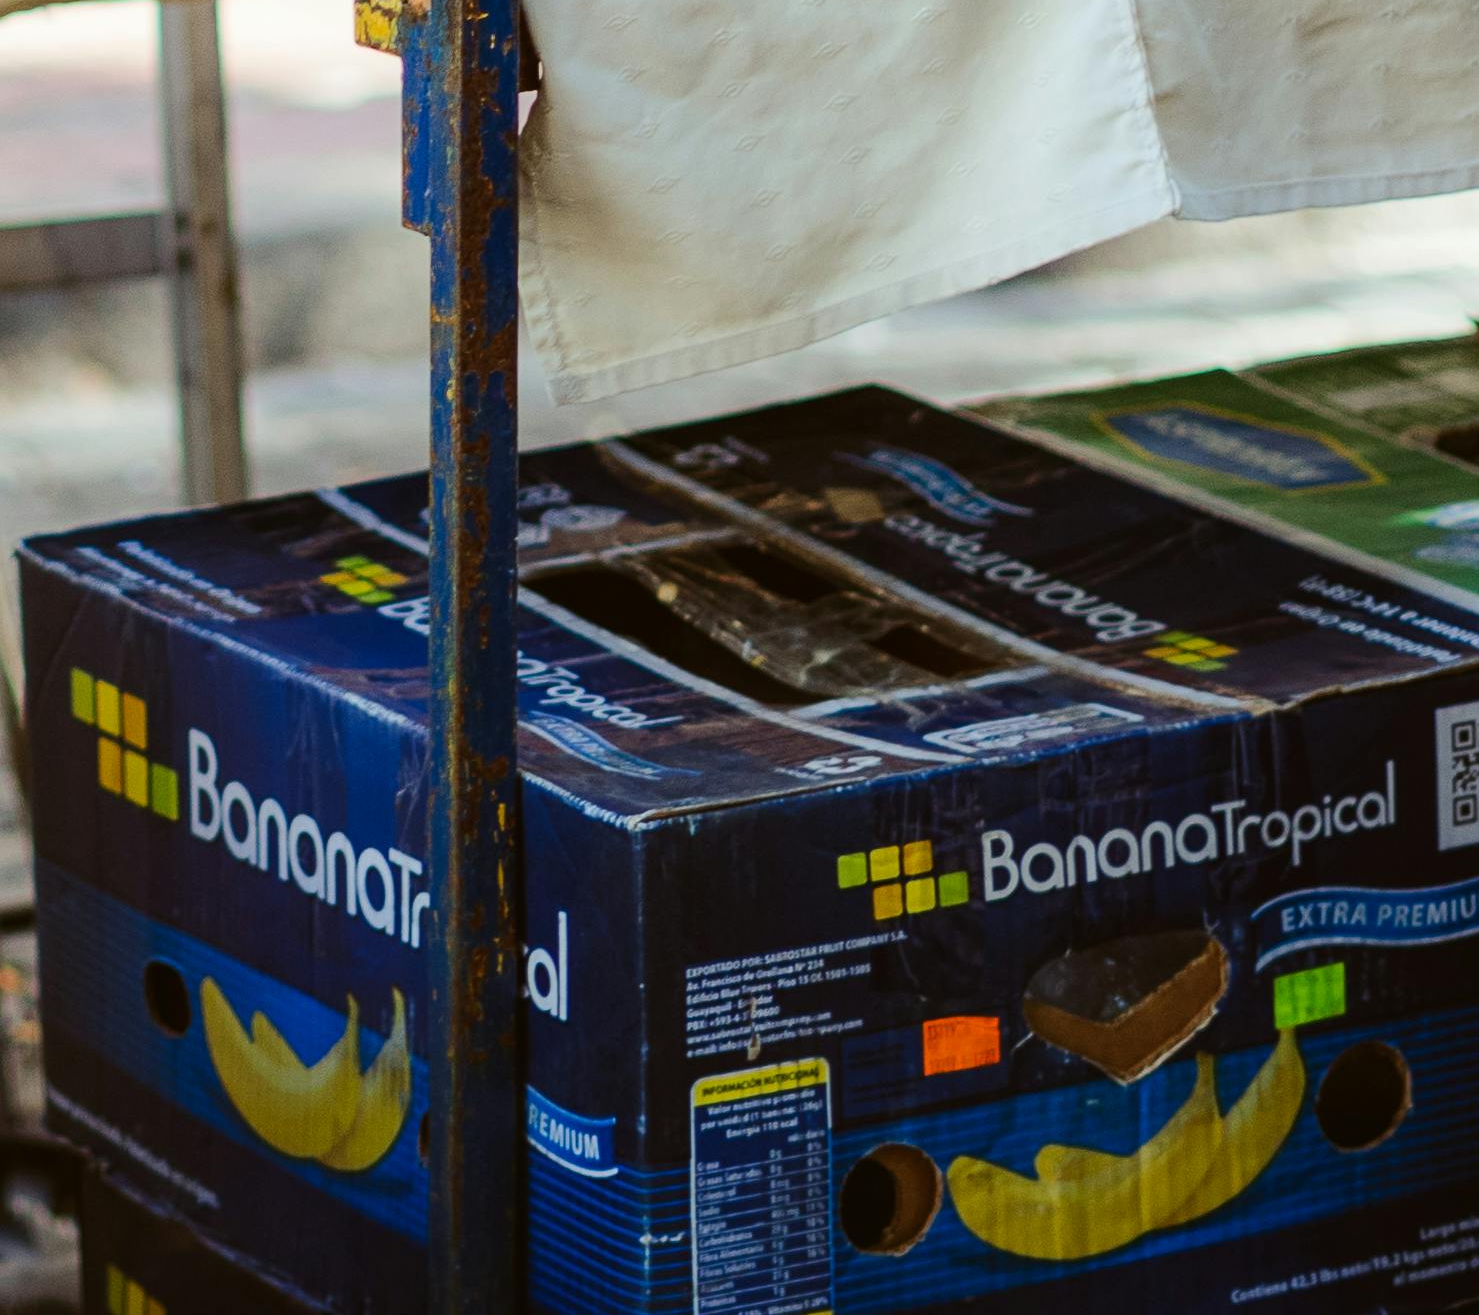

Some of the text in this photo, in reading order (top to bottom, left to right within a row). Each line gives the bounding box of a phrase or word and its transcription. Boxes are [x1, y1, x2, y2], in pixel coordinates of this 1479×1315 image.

[981, 760, 1395, 903] BananaTropical
[1281, 903, 1369, 934] EXTRA
[526, 1103, 601, 1161] REMIUM
